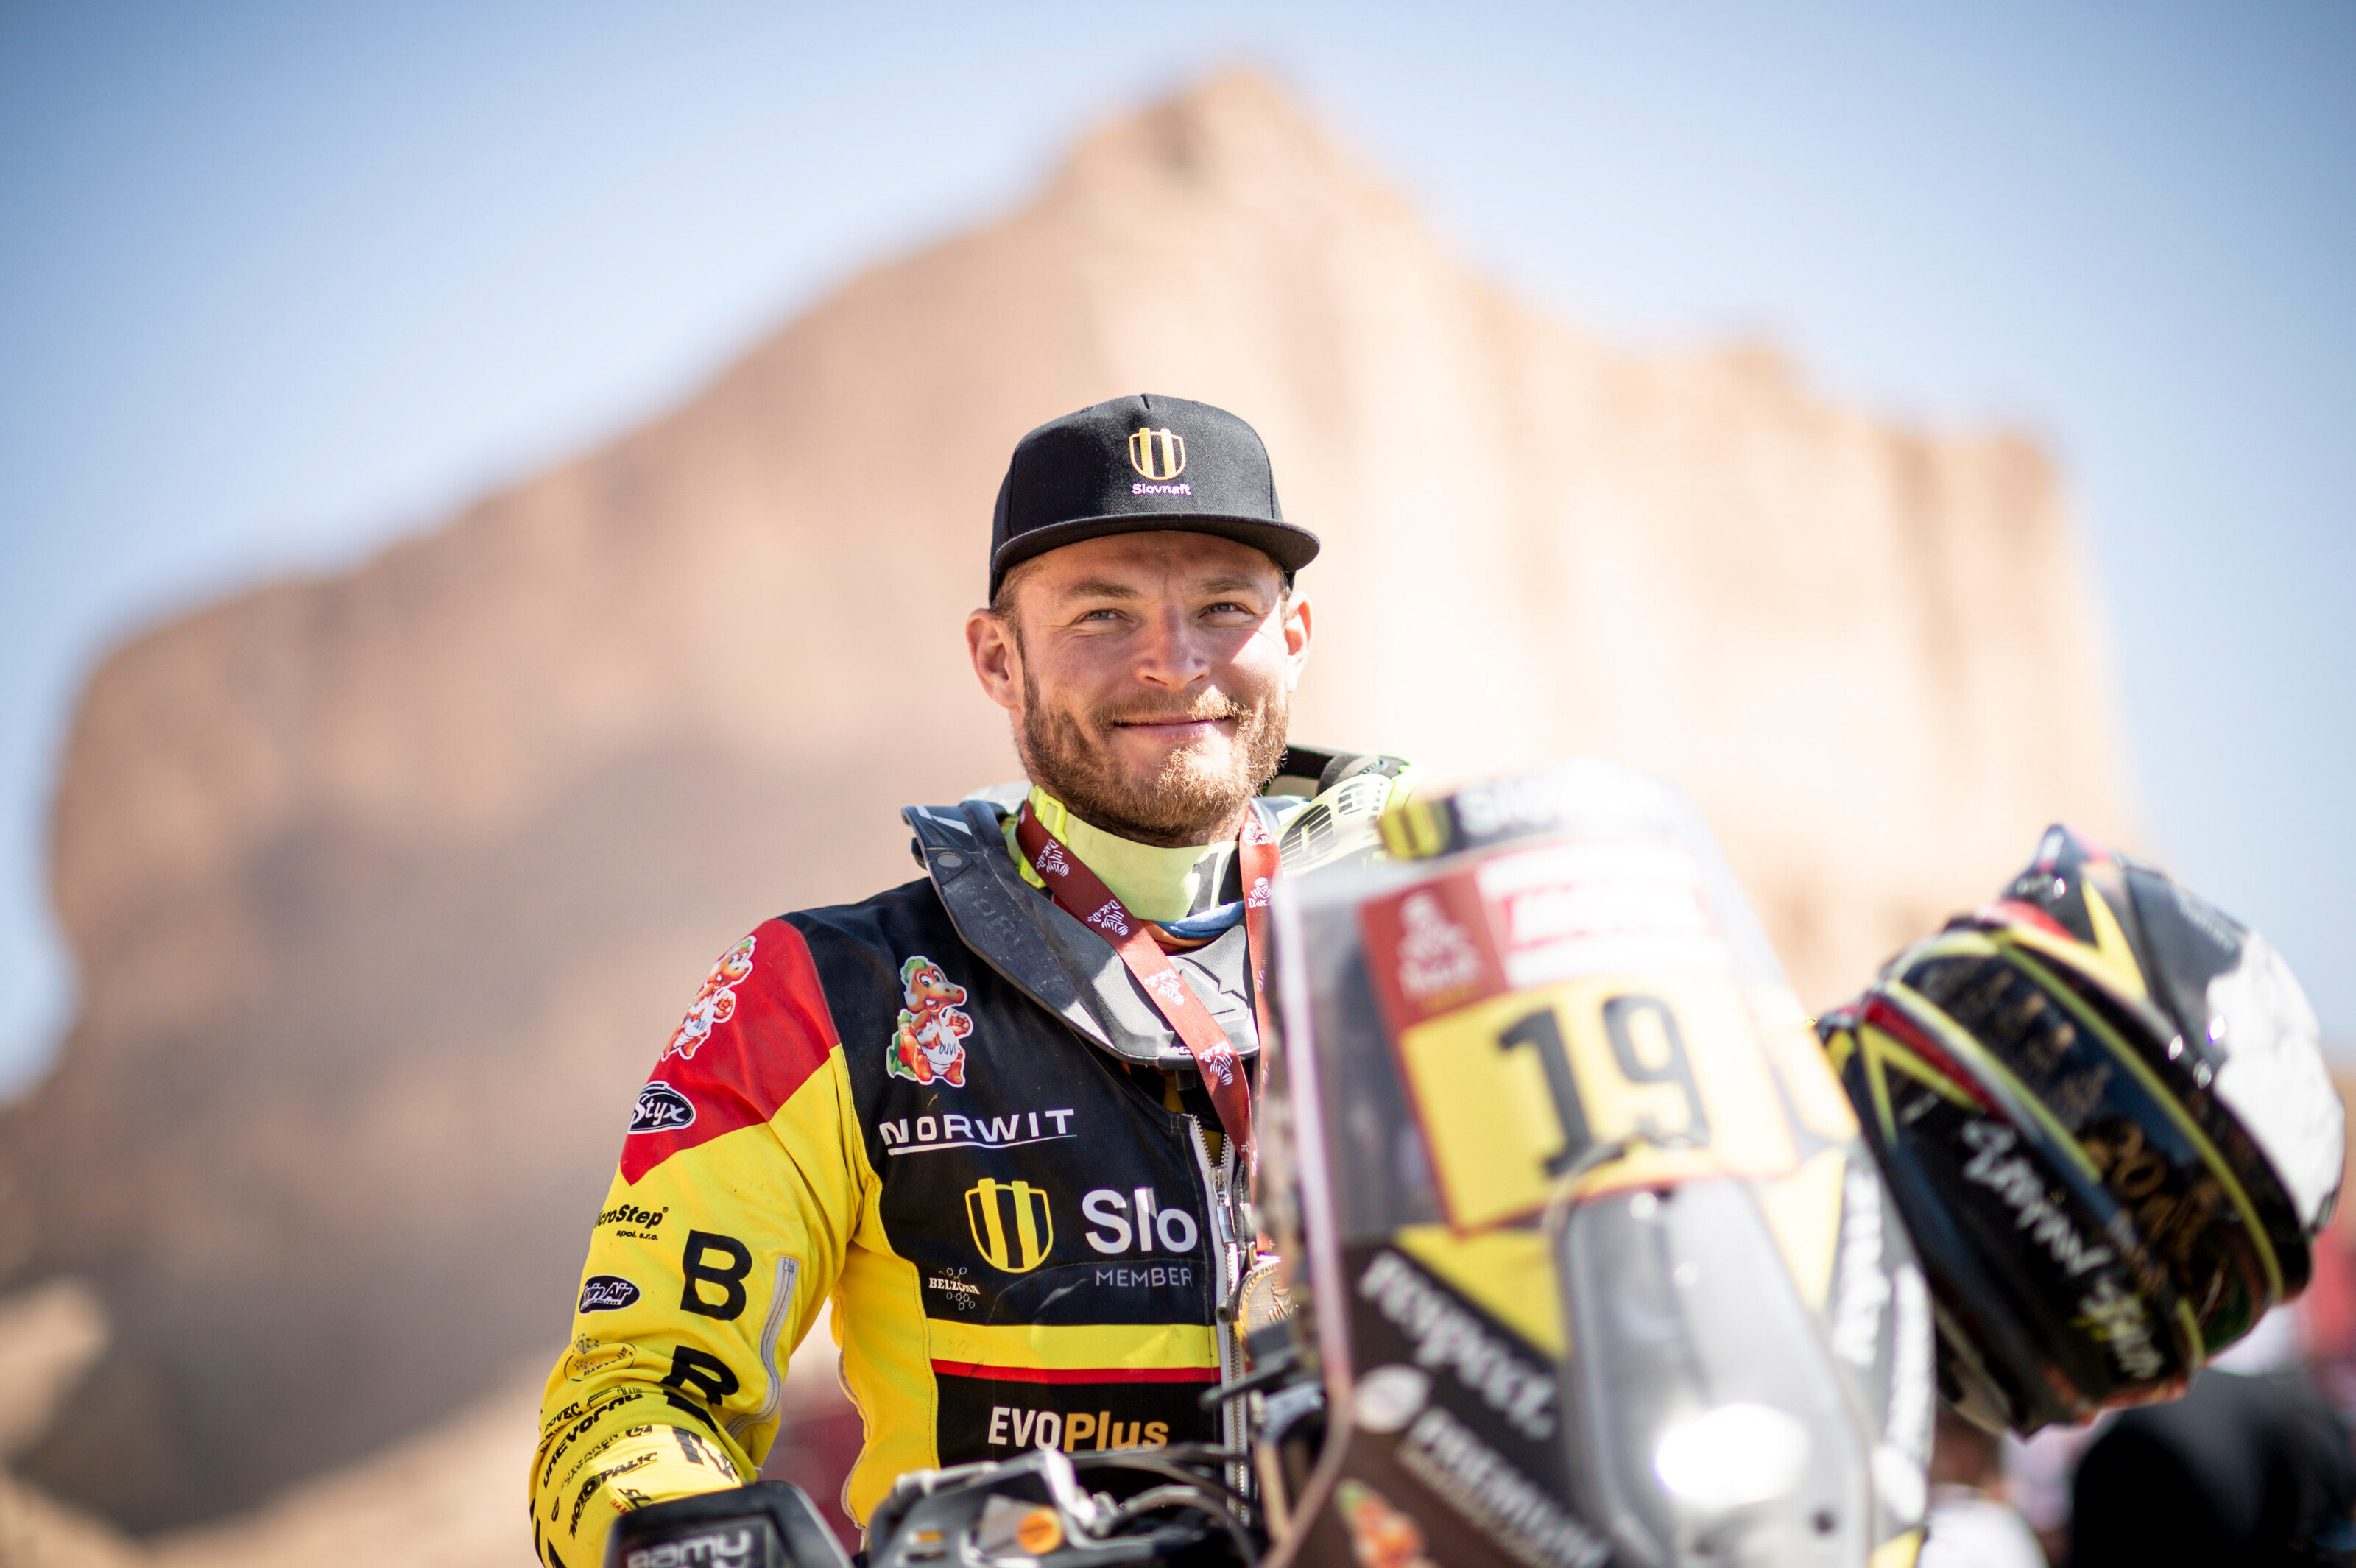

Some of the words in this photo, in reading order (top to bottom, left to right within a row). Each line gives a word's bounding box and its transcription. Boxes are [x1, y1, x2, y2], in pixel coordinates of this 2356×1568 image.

[1132, 483, 1191, 495] Slovnaft
[1087, 899, 1121, 923] DAKAR
[1248, 897, 1268, 909] DAK
[939, 1042, 956, 1056] DUVI
[1498, 995, 1710, 1179] 19
[631, 1093, 685, 1126] Styx
[879, 1109, 1074, 1145] NORWIT
[680, 1229, 752, 1321] B
[1096, 1267, 1193, 1288] MEMBER
[988, 1406, 1169, 1452] EVOPlus
